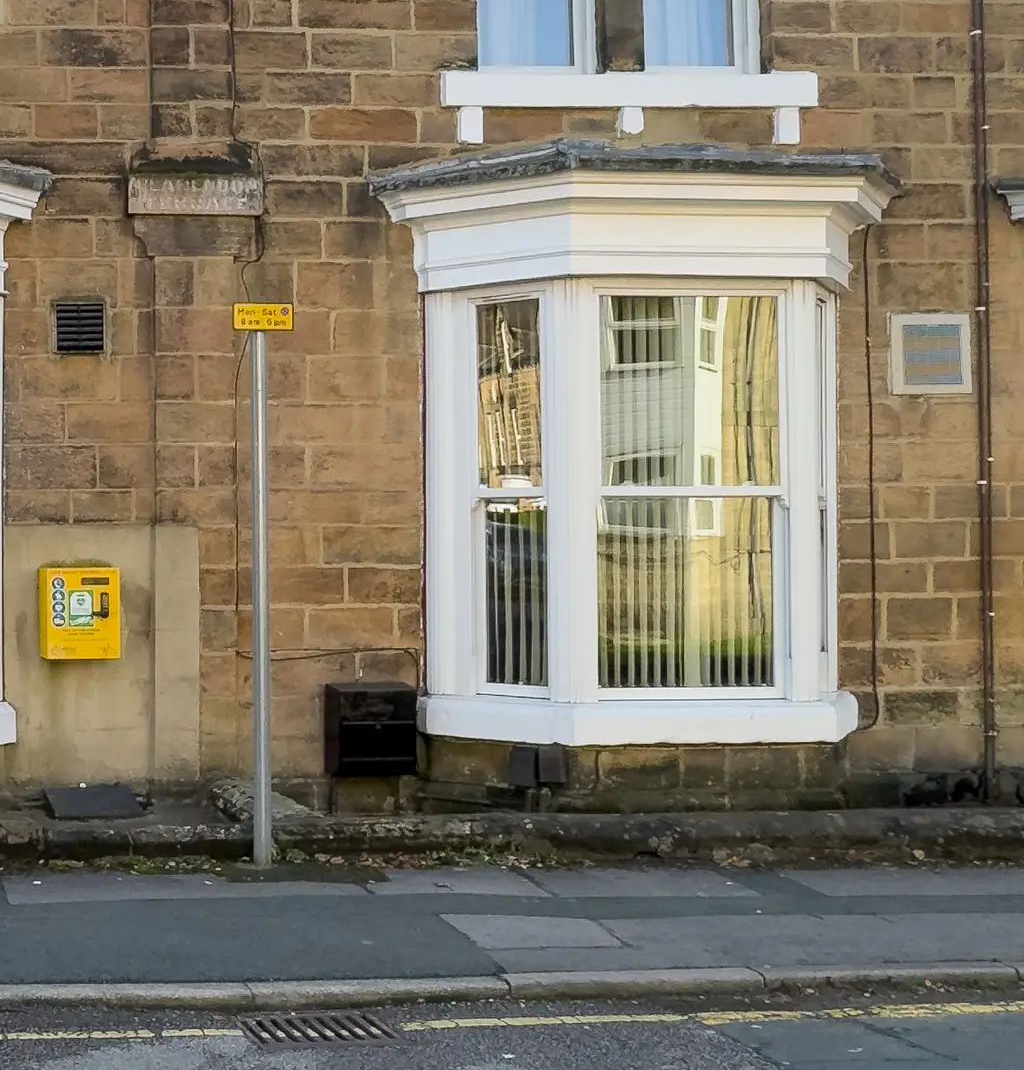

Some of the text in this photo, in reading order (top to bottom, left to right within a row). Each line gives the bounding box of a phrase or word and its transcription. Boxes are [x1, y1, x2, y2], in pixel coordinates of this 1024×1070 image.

[143, 194, 248, 210] TERRACE
[237, 307, 277, 316] Mon Sat
